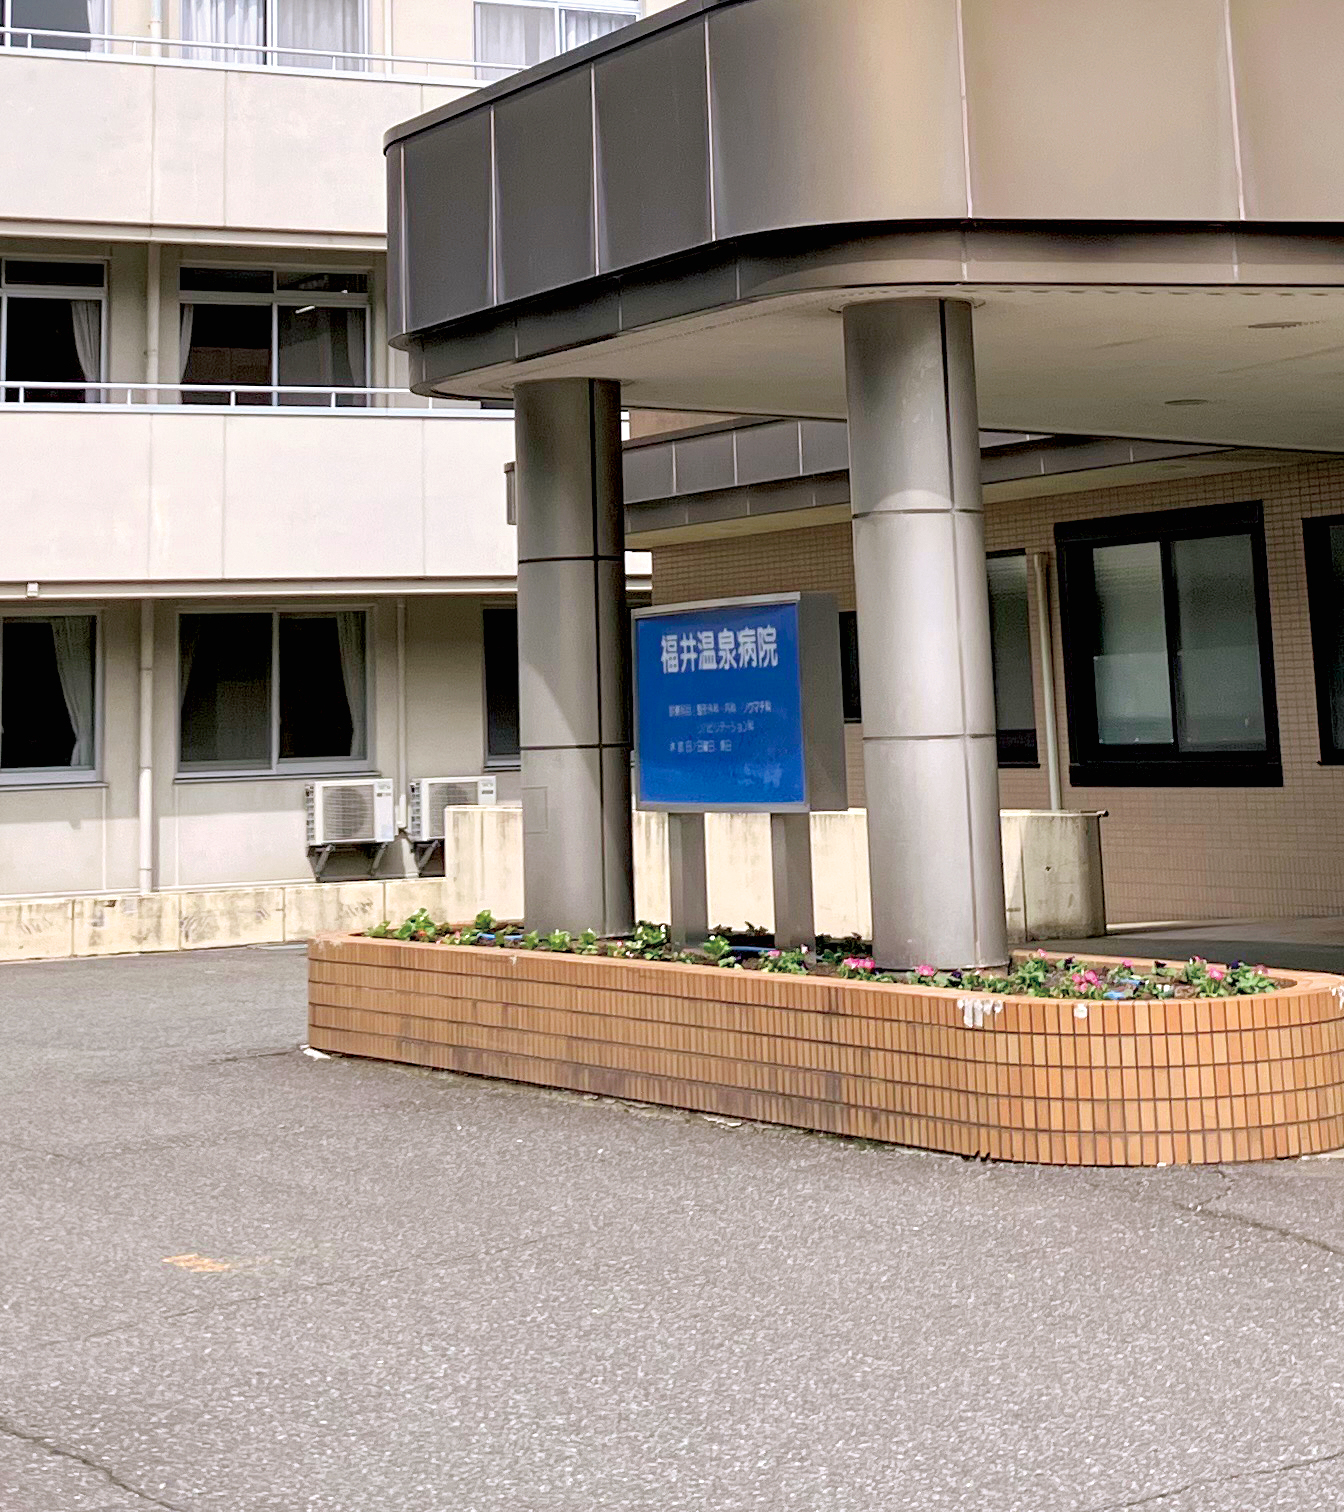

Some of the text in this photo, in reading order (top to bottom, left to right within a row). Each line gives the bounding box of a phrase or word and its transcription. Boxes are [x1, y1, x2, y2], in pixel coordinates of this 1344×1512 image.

[660, 625, 779, 674] 福井温泉病院
